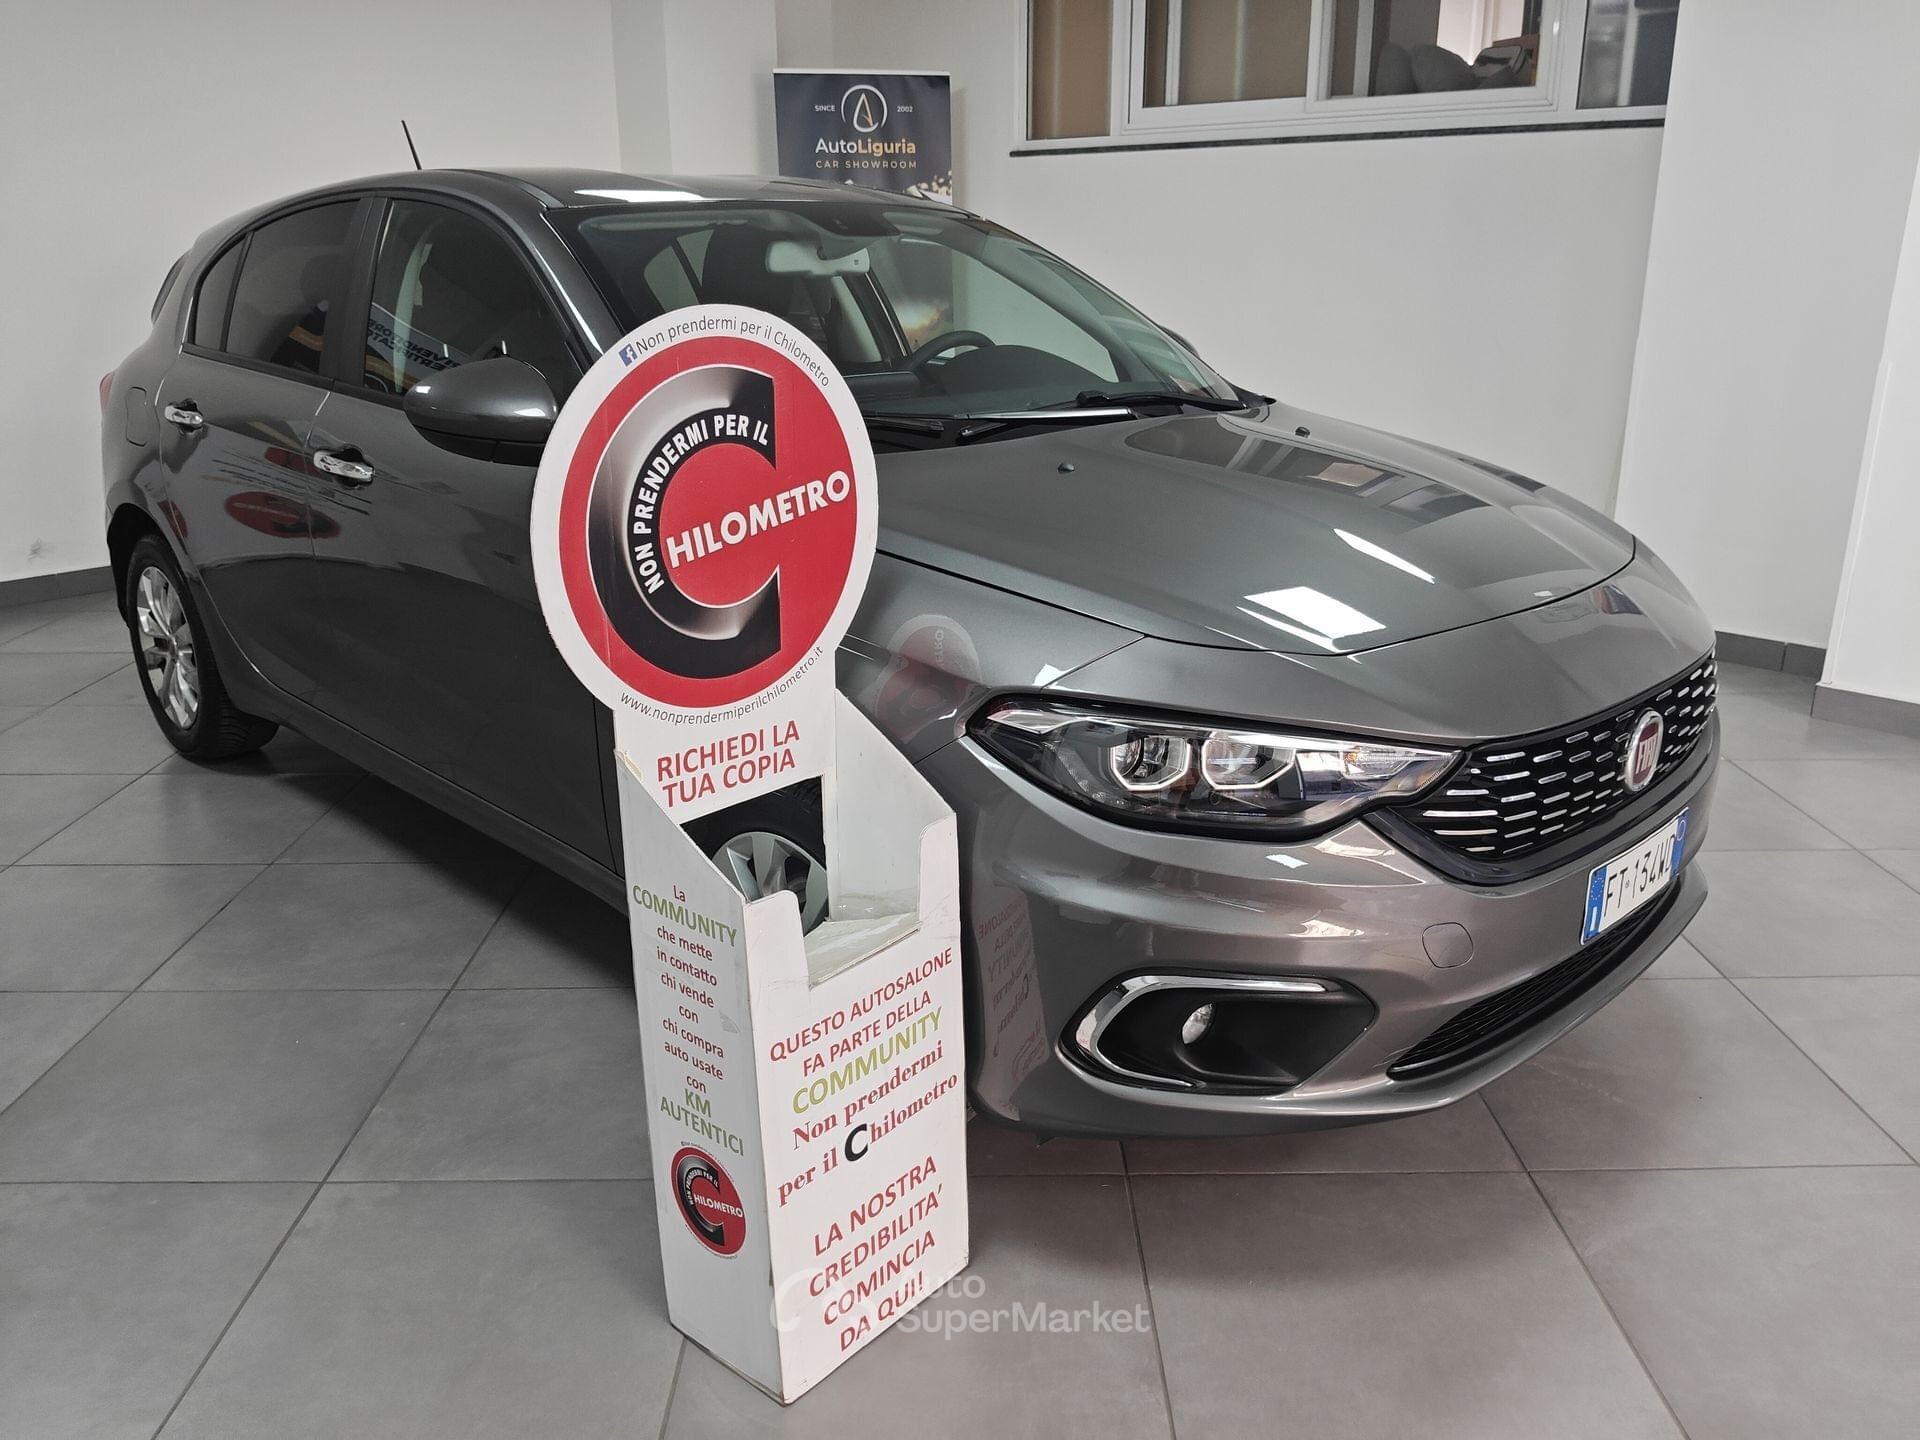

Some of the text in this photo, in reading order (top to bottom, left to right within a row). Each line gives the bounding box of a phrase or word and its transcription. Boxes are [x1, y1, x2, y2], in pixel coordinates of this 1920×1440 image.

[814, 104, 913, 113] SINCE 2002
[815, 137, 916, 157] AutoLiguria
[816, 160, 917, 169] CAR SHOWROOM
[635, 330, 665, 355] Non
[667, 315, 737, 342] prendermi
[739, 321, 762, 338] per
[763, 324, 773, 339] il
[773, 331, 830, 388] Chilometro
[633, 414, 768, 594] NON PRENDERMI PER IL
[666, 470, 850, 569] HILOMETRO
[621, 646, 824, 726] www.nonprendermiperilchilometro.it
[656, 720, 800, 782] RICHIEDI LA
[662, 748, 796, 808] TUA COPIA
[632, 885, 737, 947] COMMUNITY
[673, 885, 686, 902] La
[657, 926, 713, 961] che mette
[657, 946, 718, 986] in contatto
[661, 972, 715, 1008] chi vende
[679, 1004, 699, 1024] con
[770, 1010, 845, 1062] QUESTO
[850, 947, 953, 1022] AUTOSALONE
[663, 1017, 724, 1058] chi compra
[664, 1041, 723, 1080] auto usate
[792, 1006, 943, 1115] COMMUNITY
[803, 990, 931, 1077] FA PARTE DELLA
[684, 1087, 711, 1118] KM
[686, 1074, 707, 1094] con
[792, 1112, 838, 1150] Non
[844, 1040, 944, 1127] prendermi
[660, 1096, 744, 1156] AUTENTICI
[693, 1193, 743, 1218] HILOMETRO
[777, 1165, 816, 1208] per
[822, 1146, 839, 1175] il
[814, 1155, 937, 1257] LA NOSTRA
[809, 1183, 943, 1297] CREDIBILITA'
[823, 1230, 936, 1326] COMINCIA
[840, 1270, 924, 1352] DA QUI!
